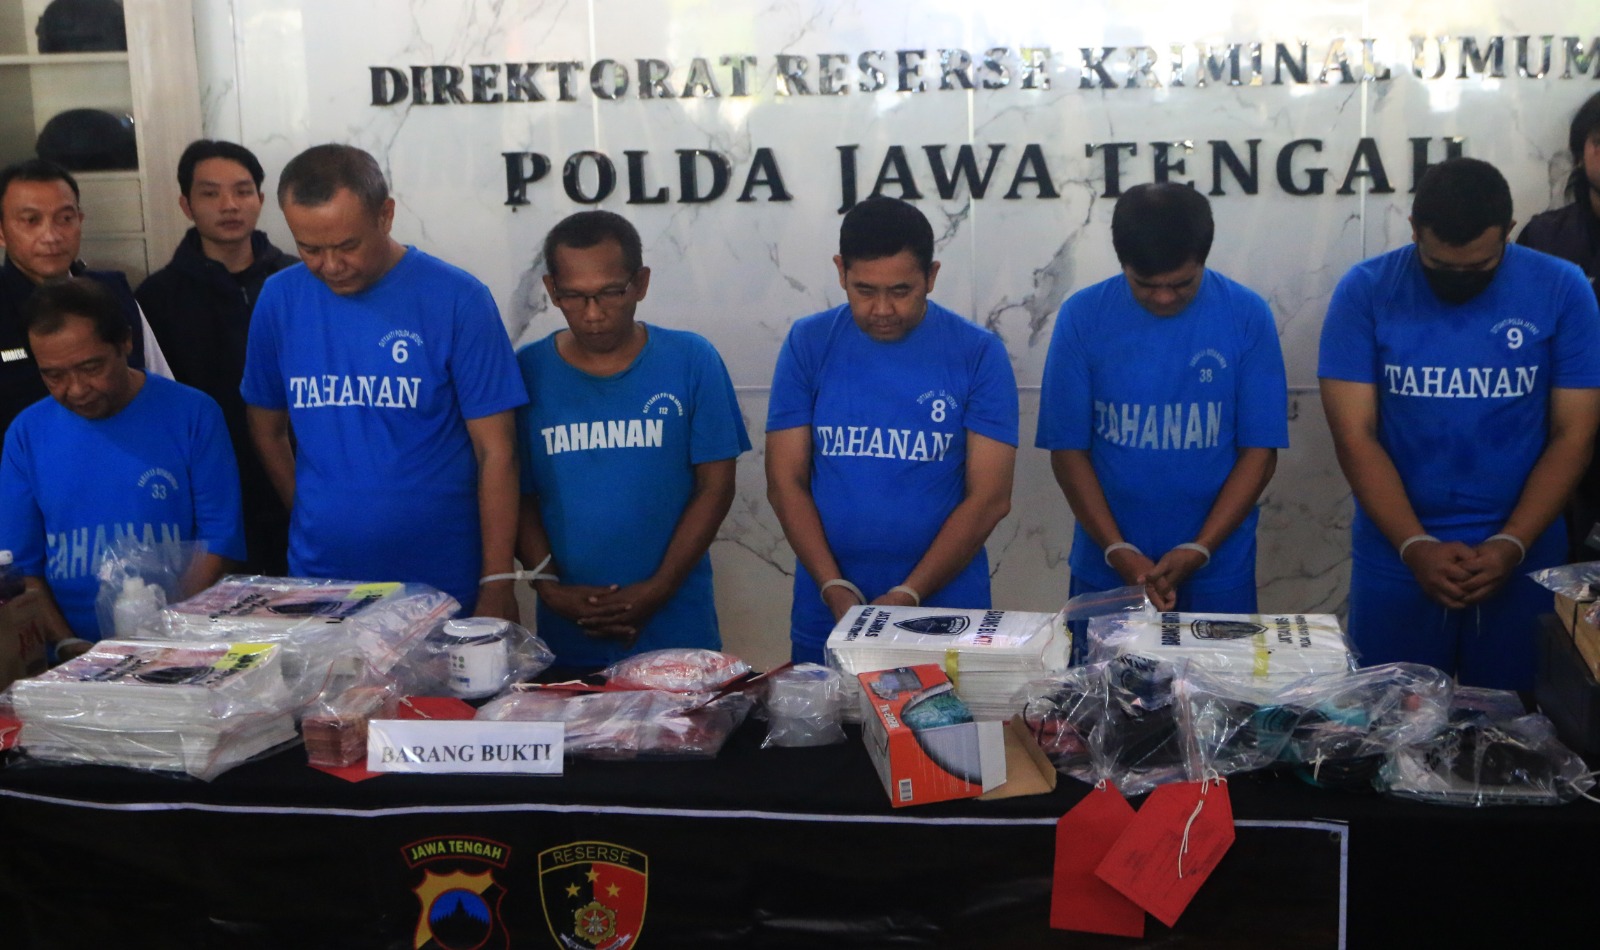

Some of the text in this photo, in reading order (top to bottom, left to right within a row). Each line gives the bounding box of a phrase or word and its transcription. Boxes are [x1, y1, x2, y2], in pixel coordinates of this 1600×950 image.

[369, 34, 1600, 106] DIREKTORAT RESERSE KRIMINAL UMUM
[501, 136, 1465, 215] POLDA JAWA TENGAH
[1506, 327, 1523, 349] 9
[391, 340, 408, 364] 6
[1199, 368, 1213, 383] 38
[1384, 364, 1539, 398] TAHANAN
[290, 374, 422, 409] TAHANAN
[931, 399, 946, 423] 8
[1094, 400, 1222, 450] TAHANAN
[541, 419, 664, 456] TAHANAN
[817, 426, 953, 462] TAHANAN
[151, 484, 167, 500] 33
[980, 610, 1005, 628] BARANG
[381, 743, 552, 763] BARANG BUKTI
[411, 840, 502, 860] JAWA TENGAH
[553, 846, 630, 865] RESERSE
